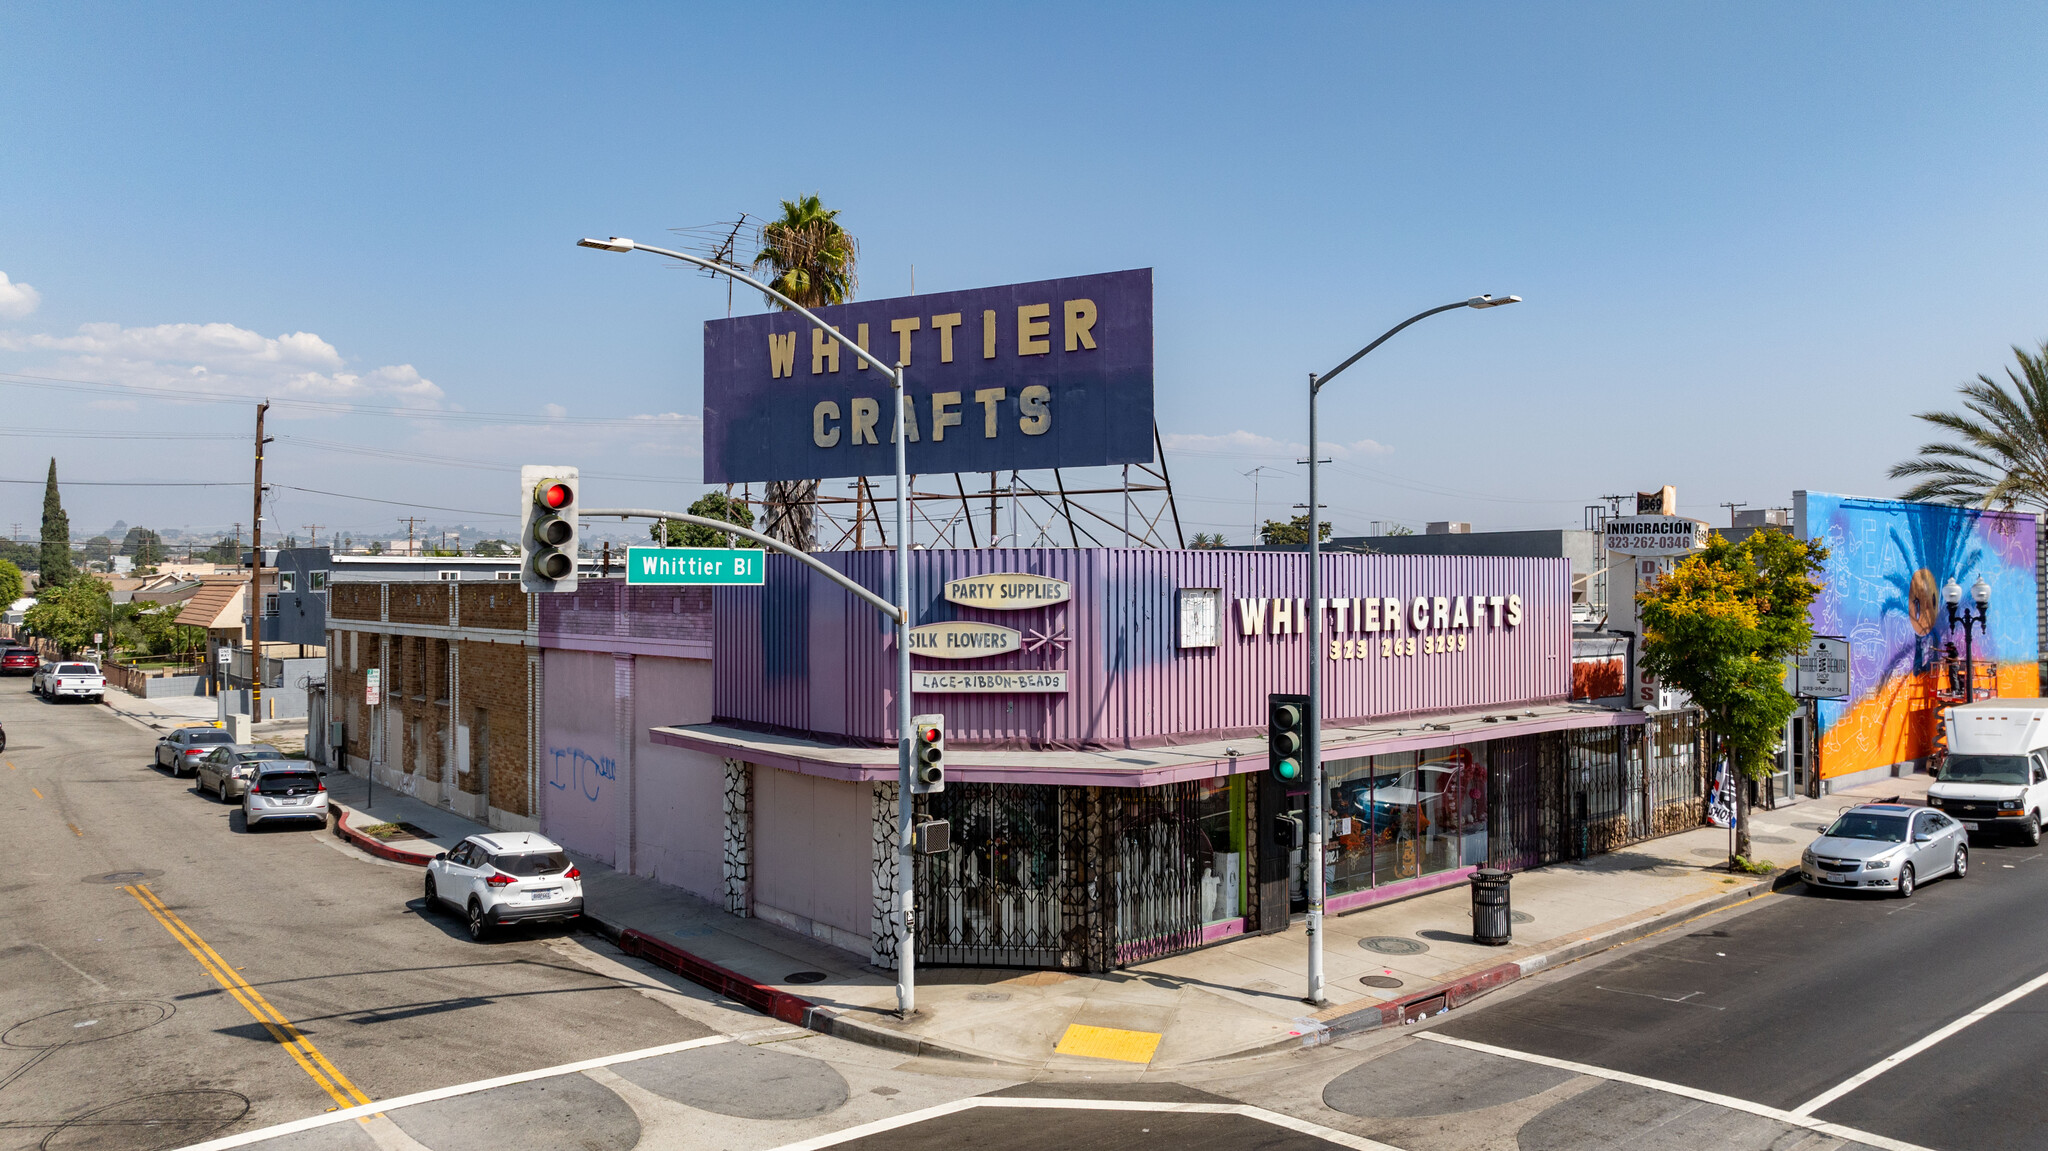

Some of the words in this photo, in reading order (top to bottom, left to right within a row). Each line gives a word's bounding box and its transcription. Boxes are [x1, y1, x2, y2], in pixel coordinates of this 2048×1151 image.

[768, 298, 1098, 379] WHITTIER
[812, 385, 1052, 448] CRAFTS
[1607, 520, 1692, 535] INMIGRACIÓN
[1608, 536, 1690, 549] 323-262-0346
[642, 556, 723, 576] Whittier
[952, 583, 995, 600] PARTY
[1000, 583, 1062, 600] SUPPLIES
[1411, 593, 1523, 631] CRAFTS
[908, 632, 938, 648] SILK
[946, 632, 1008, 649] FLOWERS
[1329, 640, 1368, 660] 323
[1381, 637, 1417, 657] 263
[1423, 634, 1467, 655] 3299
[922, 674, 1061, 689] LACE-RIBBON-BEADS
